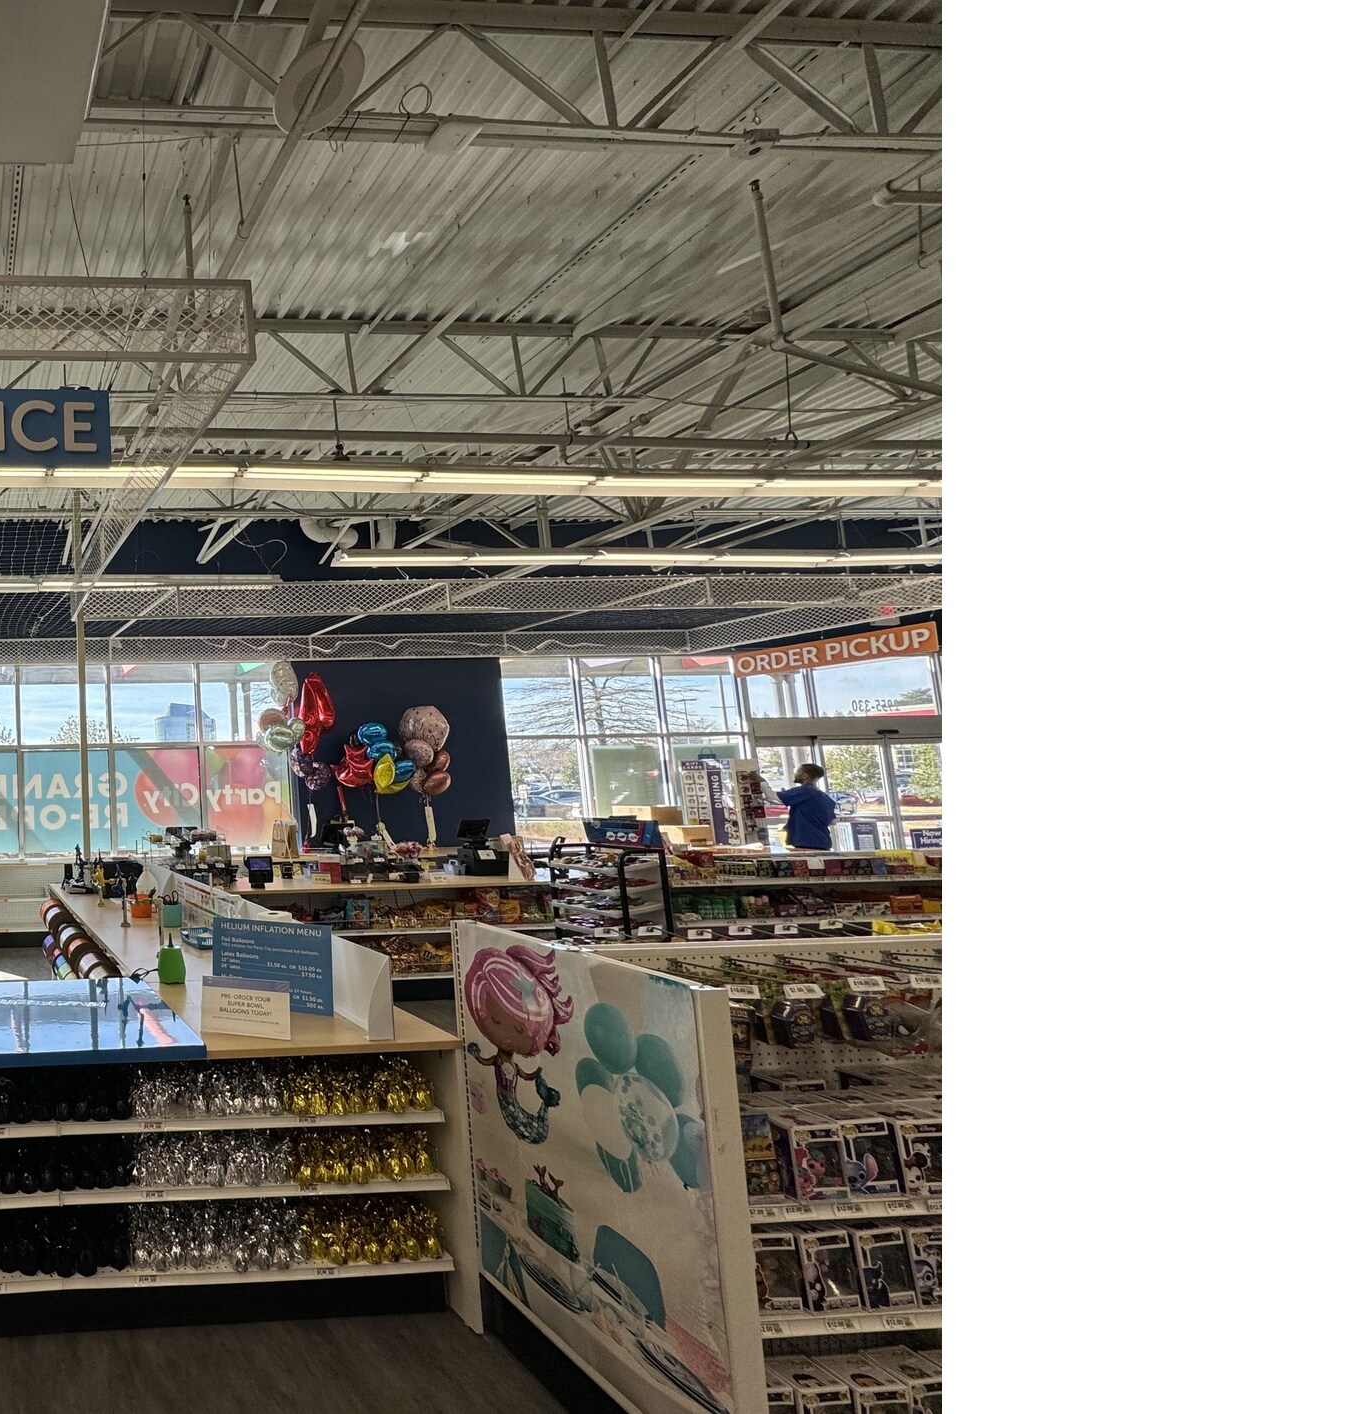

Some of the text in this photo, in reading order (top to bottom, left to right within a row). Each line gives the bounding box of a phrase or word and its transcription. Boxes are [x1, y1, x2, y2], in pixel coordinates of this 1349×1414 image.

[737, 628, 930, 674] ORDER PICKUP
[711, 775, 722, 808] DINING
[920, 837, 942, 845] Hiring
[221, 922, 322, 937] HELIUM INFLATION MENU
[221, 993, 253, 1001] PRE-ORDER
[219, 1006, 250, 1015] BALLOONS
[827, 1320, 844, 1328] $12.00
